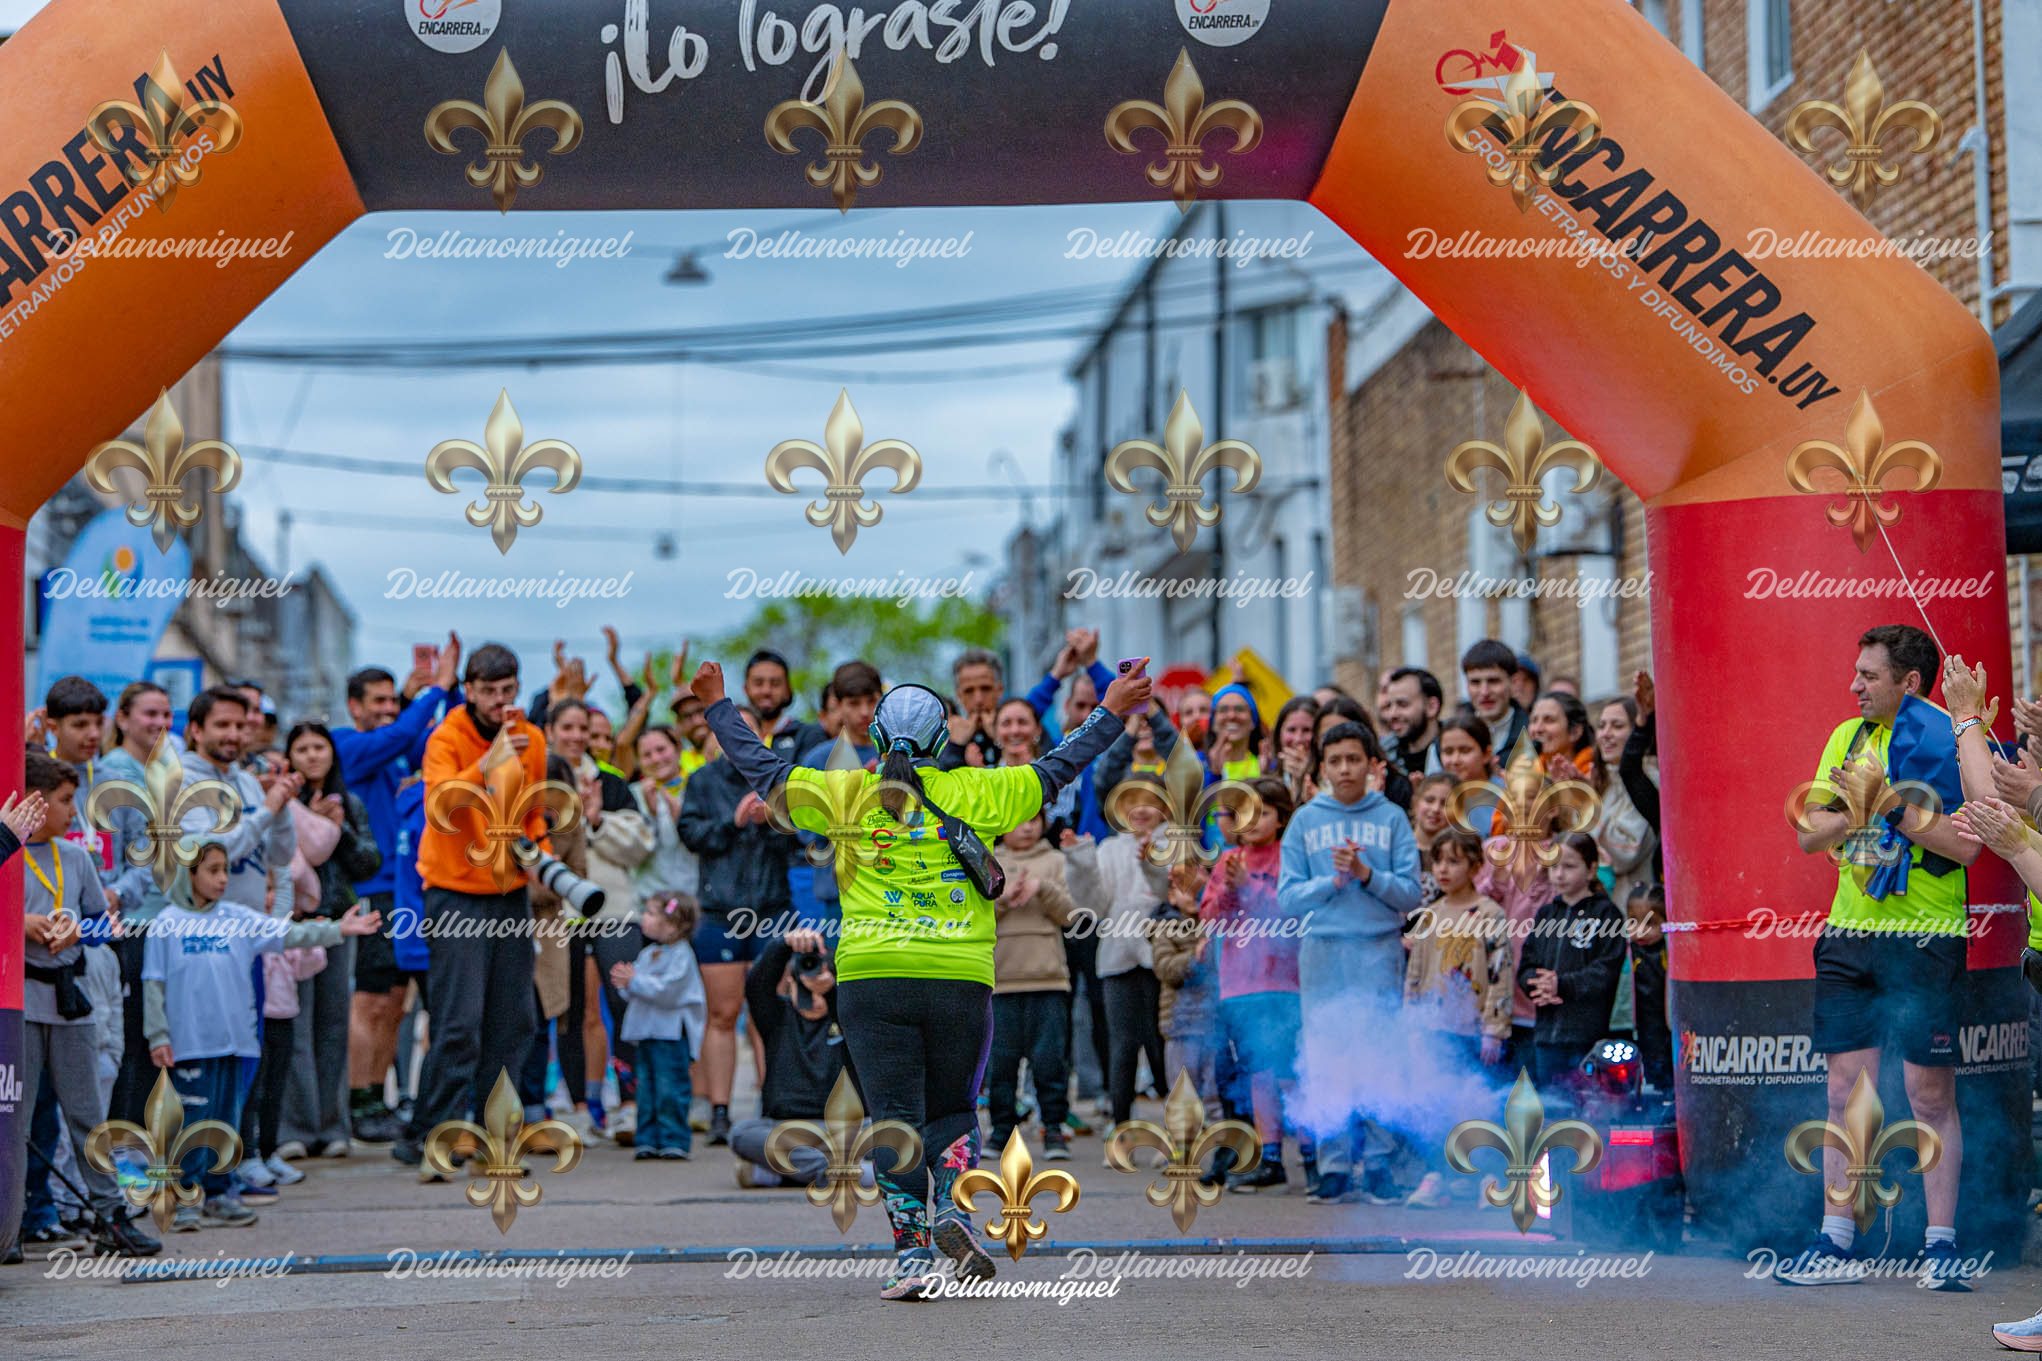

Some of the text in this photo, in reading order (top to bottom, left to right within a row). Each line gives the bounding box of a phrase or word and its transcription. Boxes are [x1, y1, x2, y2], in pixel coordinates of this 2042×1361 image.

[0, 252, 86, 342] ETRAMOS
[1626, 274, 1646, 291] Y
[1639, 289, 1760, 395] DIFUNDIMOS
[911, 892, 937, 900] AQUA
[913, 900, 938, 908] PURA
[1756, 1075, 1764, 1085] Y
